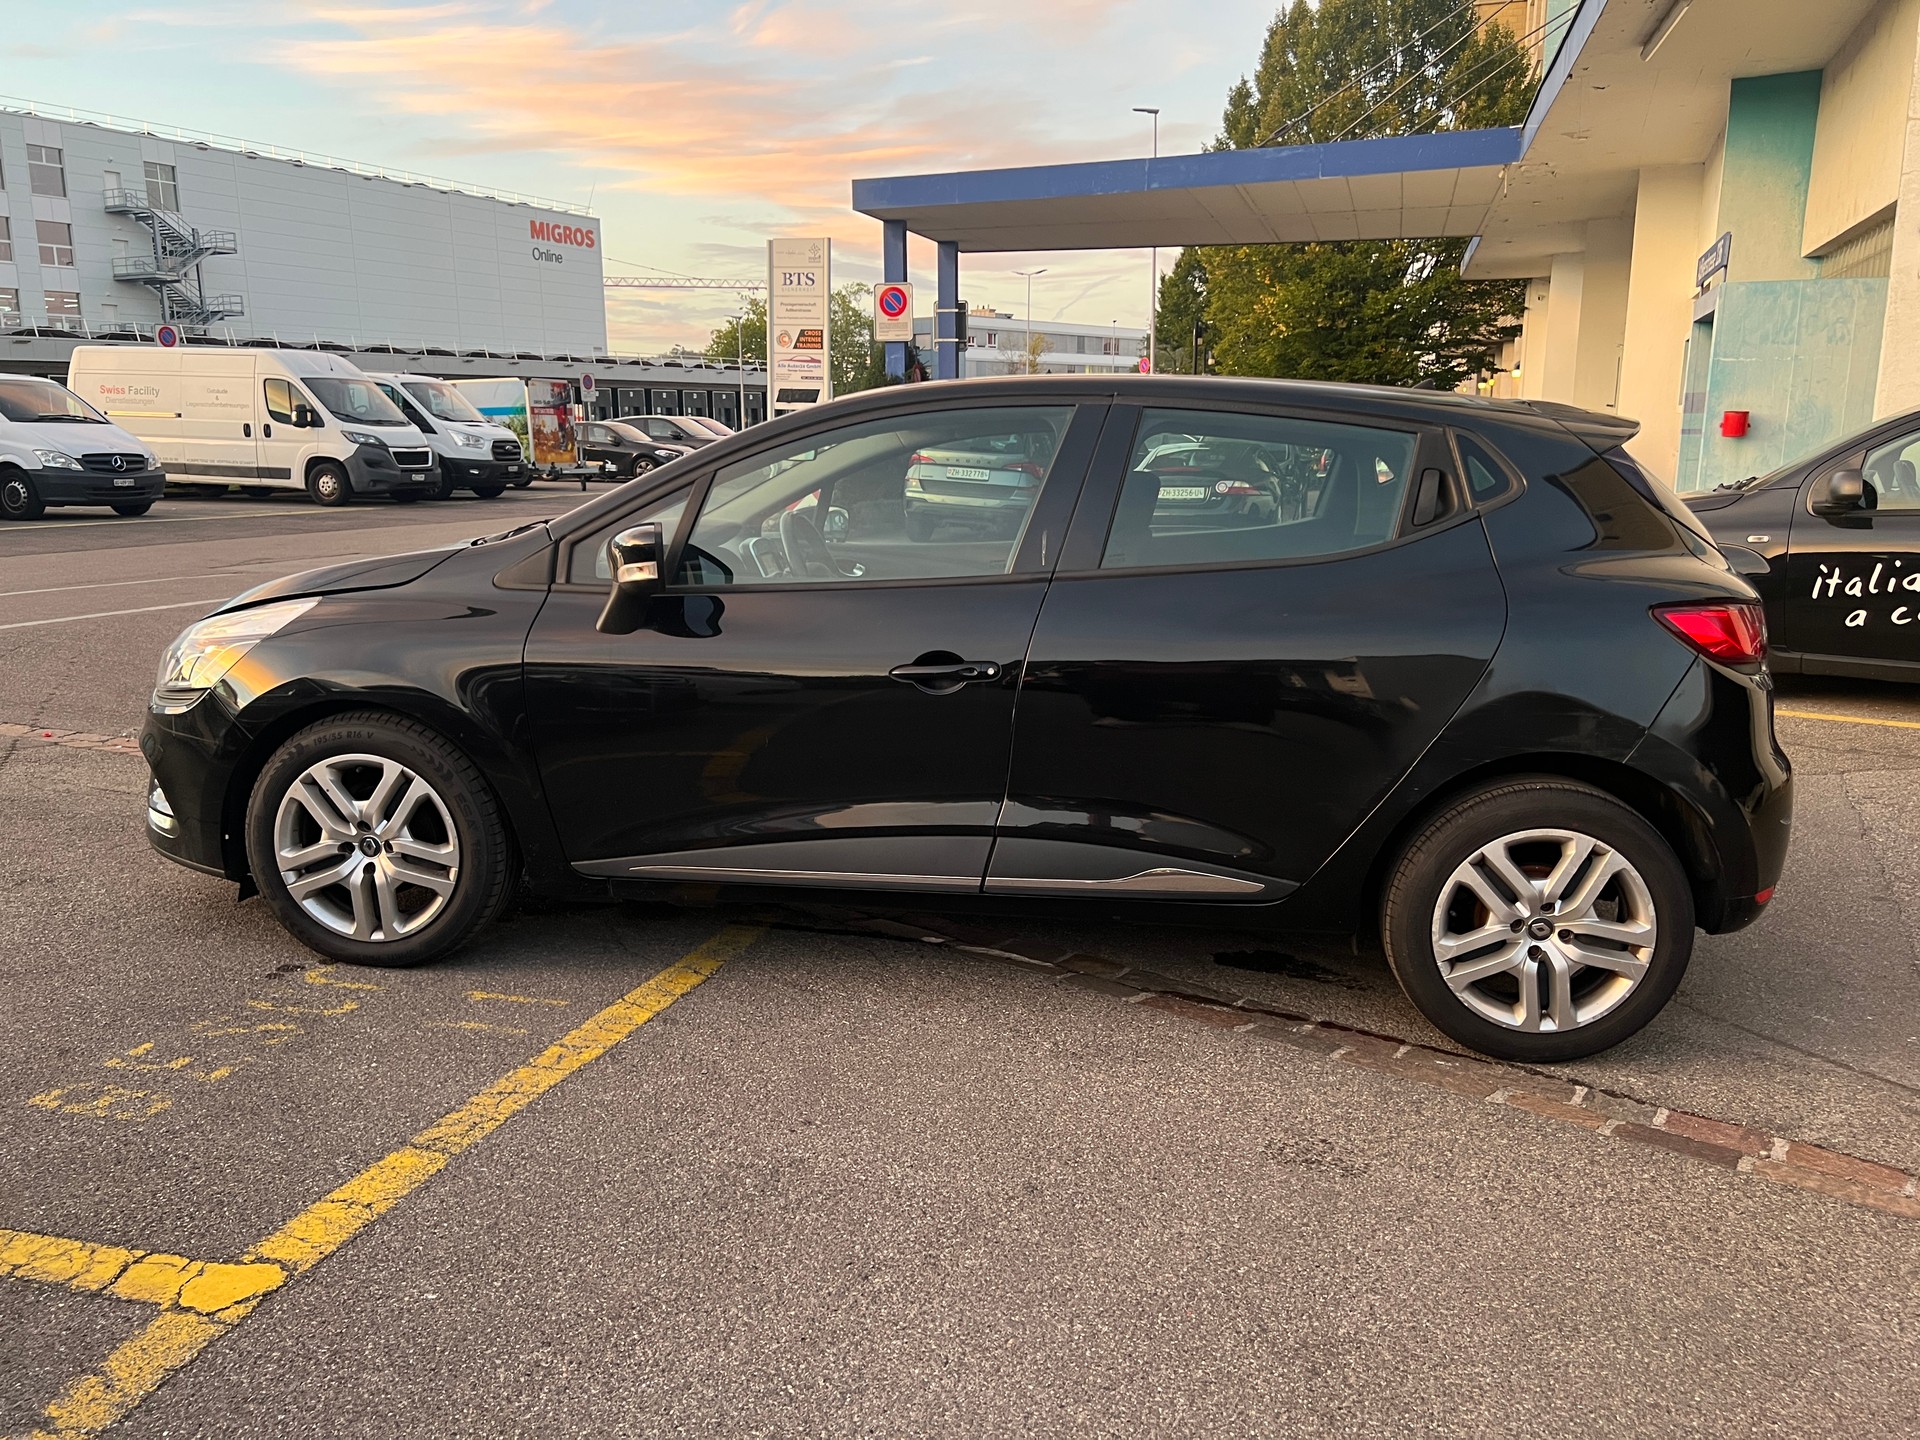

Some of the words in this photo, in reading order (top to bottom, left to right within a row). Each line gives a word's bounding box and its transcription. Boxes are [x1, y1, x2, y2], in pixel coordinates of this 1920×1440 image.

[530, 220, 595, 248] MIGROS
[532, 247, 563, 264] Online
[782, 272, 815, 286] BTS
[99, 385, 126, 395] Swiss
[128, 386, 161, 398] Facility
[1845, 609, 1867, 627] a
[1891, 606, 1920, 625] c
[313, 731, 343, 746] 195/55
[346, 730, 362, 739] R16
[367, 731, 375, 739] V
